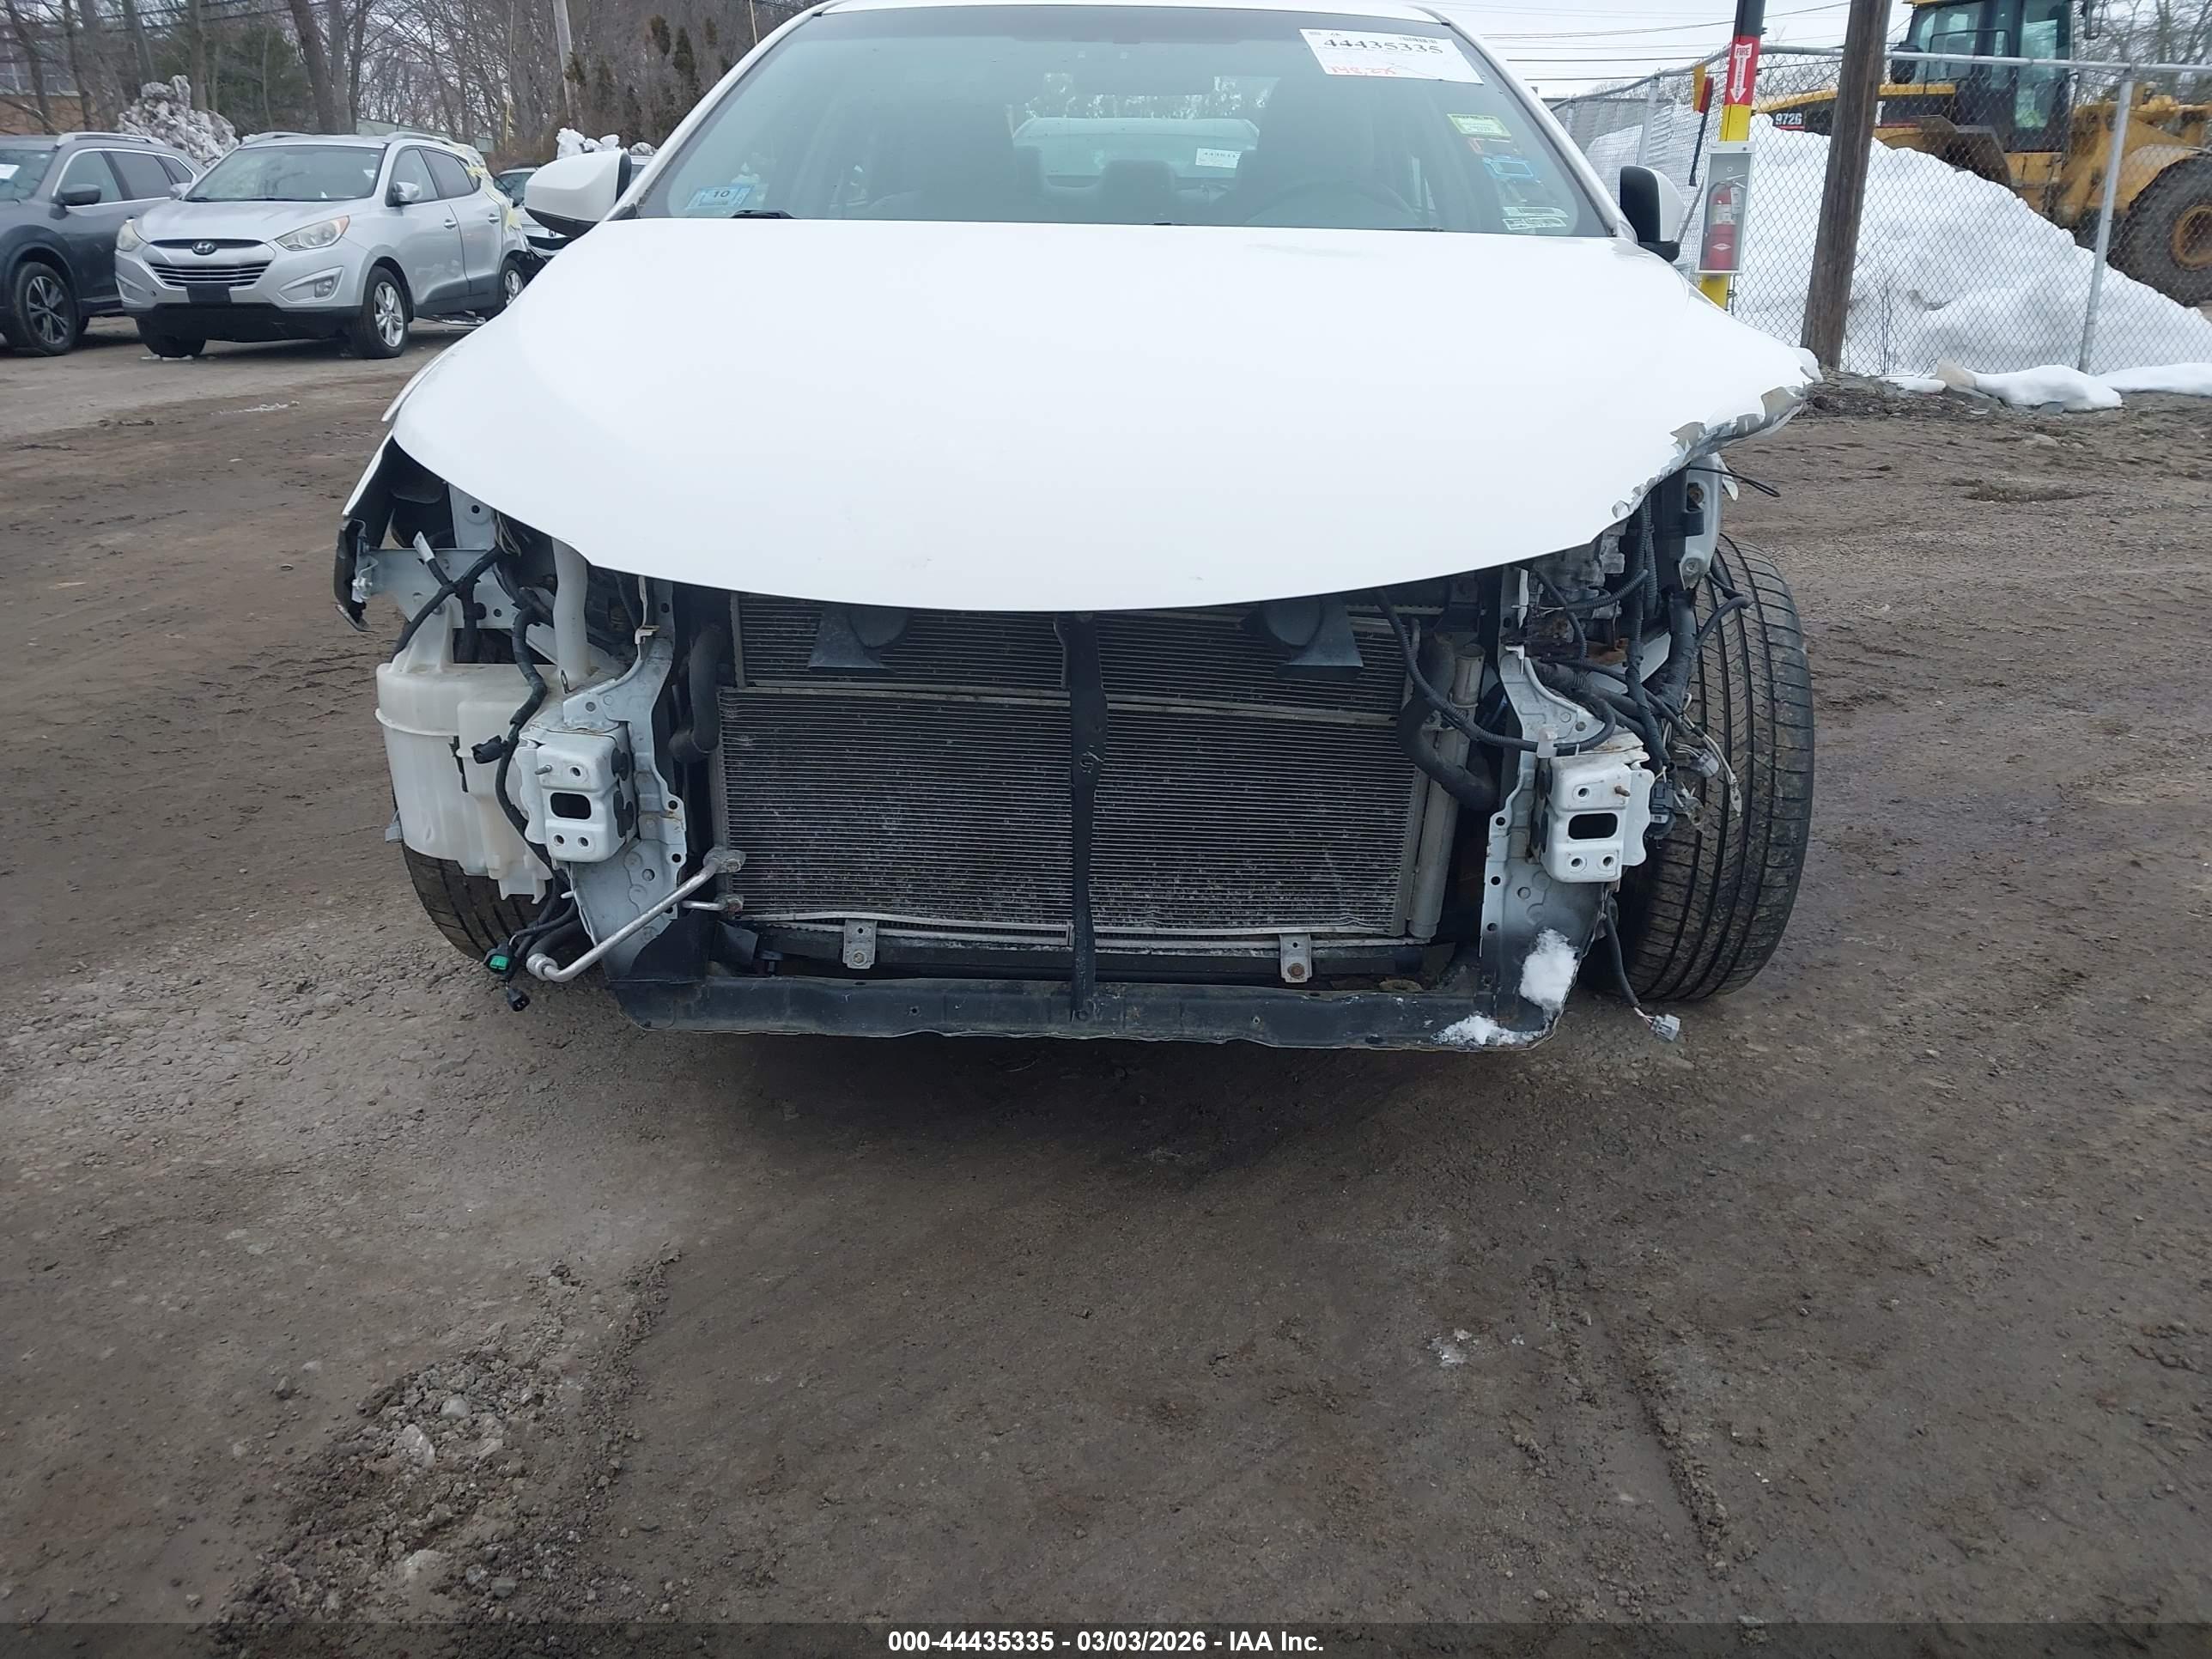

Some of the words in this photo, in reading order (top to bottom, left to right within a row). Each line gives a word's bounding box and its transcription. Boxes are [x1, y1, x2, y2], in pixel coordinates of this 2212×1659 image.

[1323, 39, 1443, 54] 44435335
[1735, 47, 1751, 56] FIRE
[1775, 112, 1802, 125] 972G
[714, 190, 731, 198] 10
